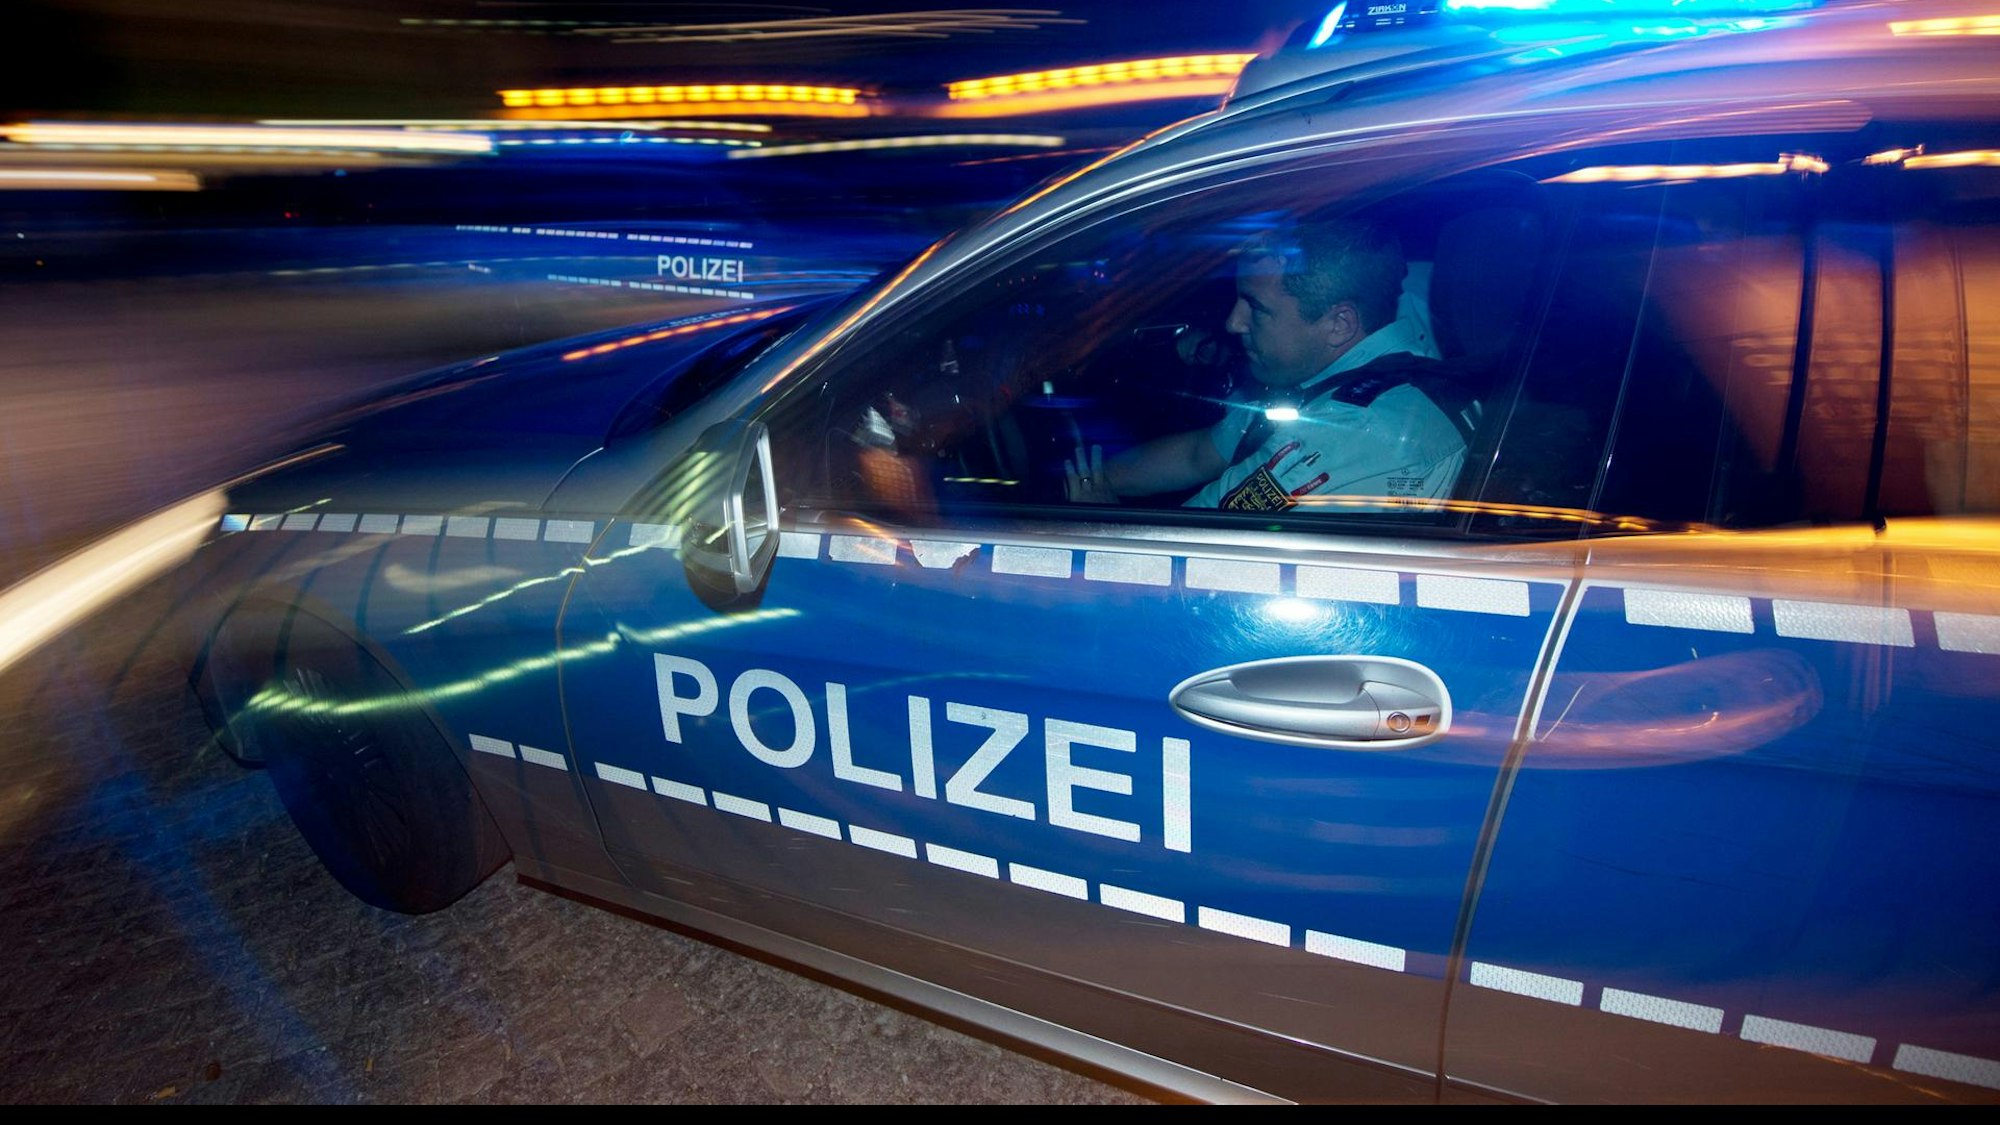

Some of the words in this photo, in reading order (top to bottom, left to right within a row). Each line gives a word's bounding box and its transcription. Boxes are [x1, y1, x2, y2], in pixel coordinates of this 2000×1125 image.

[657, 255, 743, 282] POLIZEI
[1257, 473, 1283, 505] POLIZEI
[653, 652, 1191, 853] POLIZEI
